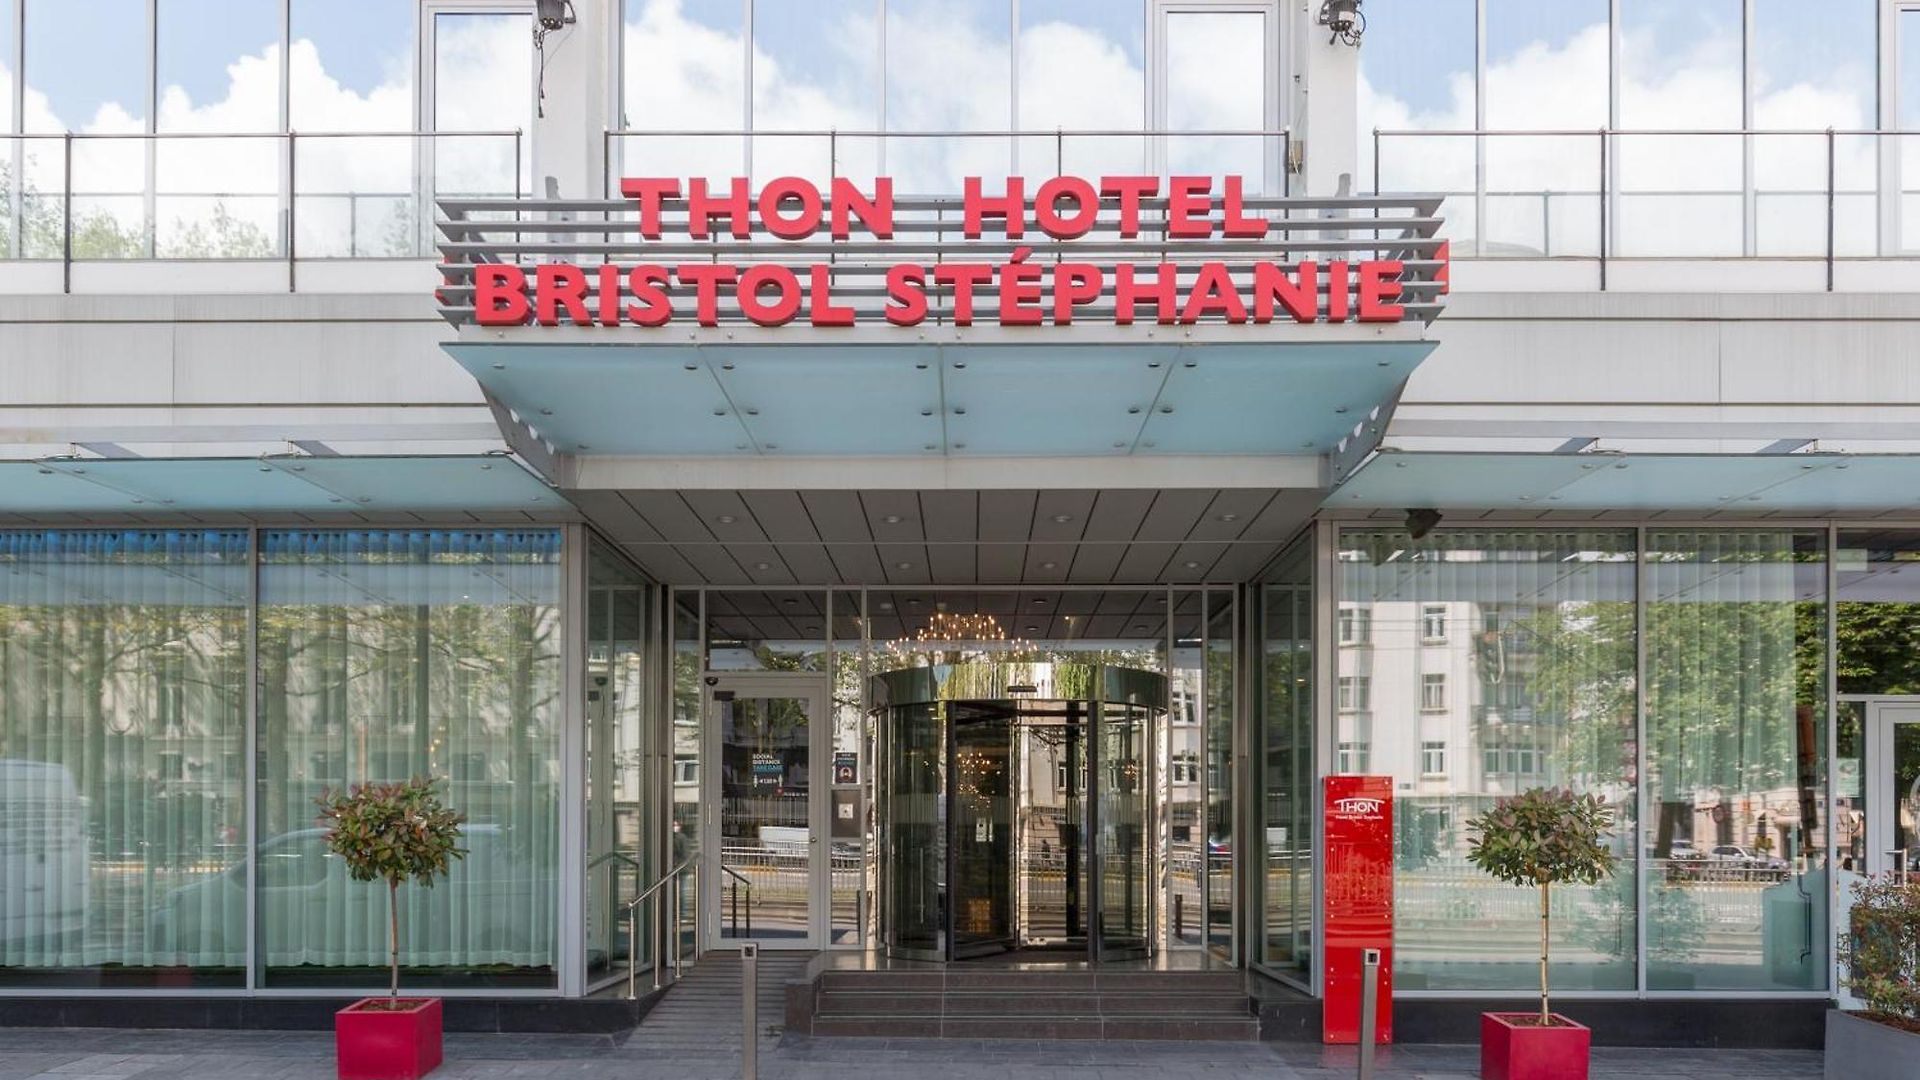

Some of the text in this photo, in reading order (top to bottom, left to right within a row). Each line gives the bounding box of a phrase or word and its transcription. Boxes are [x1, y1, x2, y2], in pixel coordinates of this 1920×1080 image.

[621, 176, 1269, 240] THON HOTEL
[474, 246, 1404, 327] BRISTOL STÉPHANIE
[1334, 797, 1385, 813] THON
